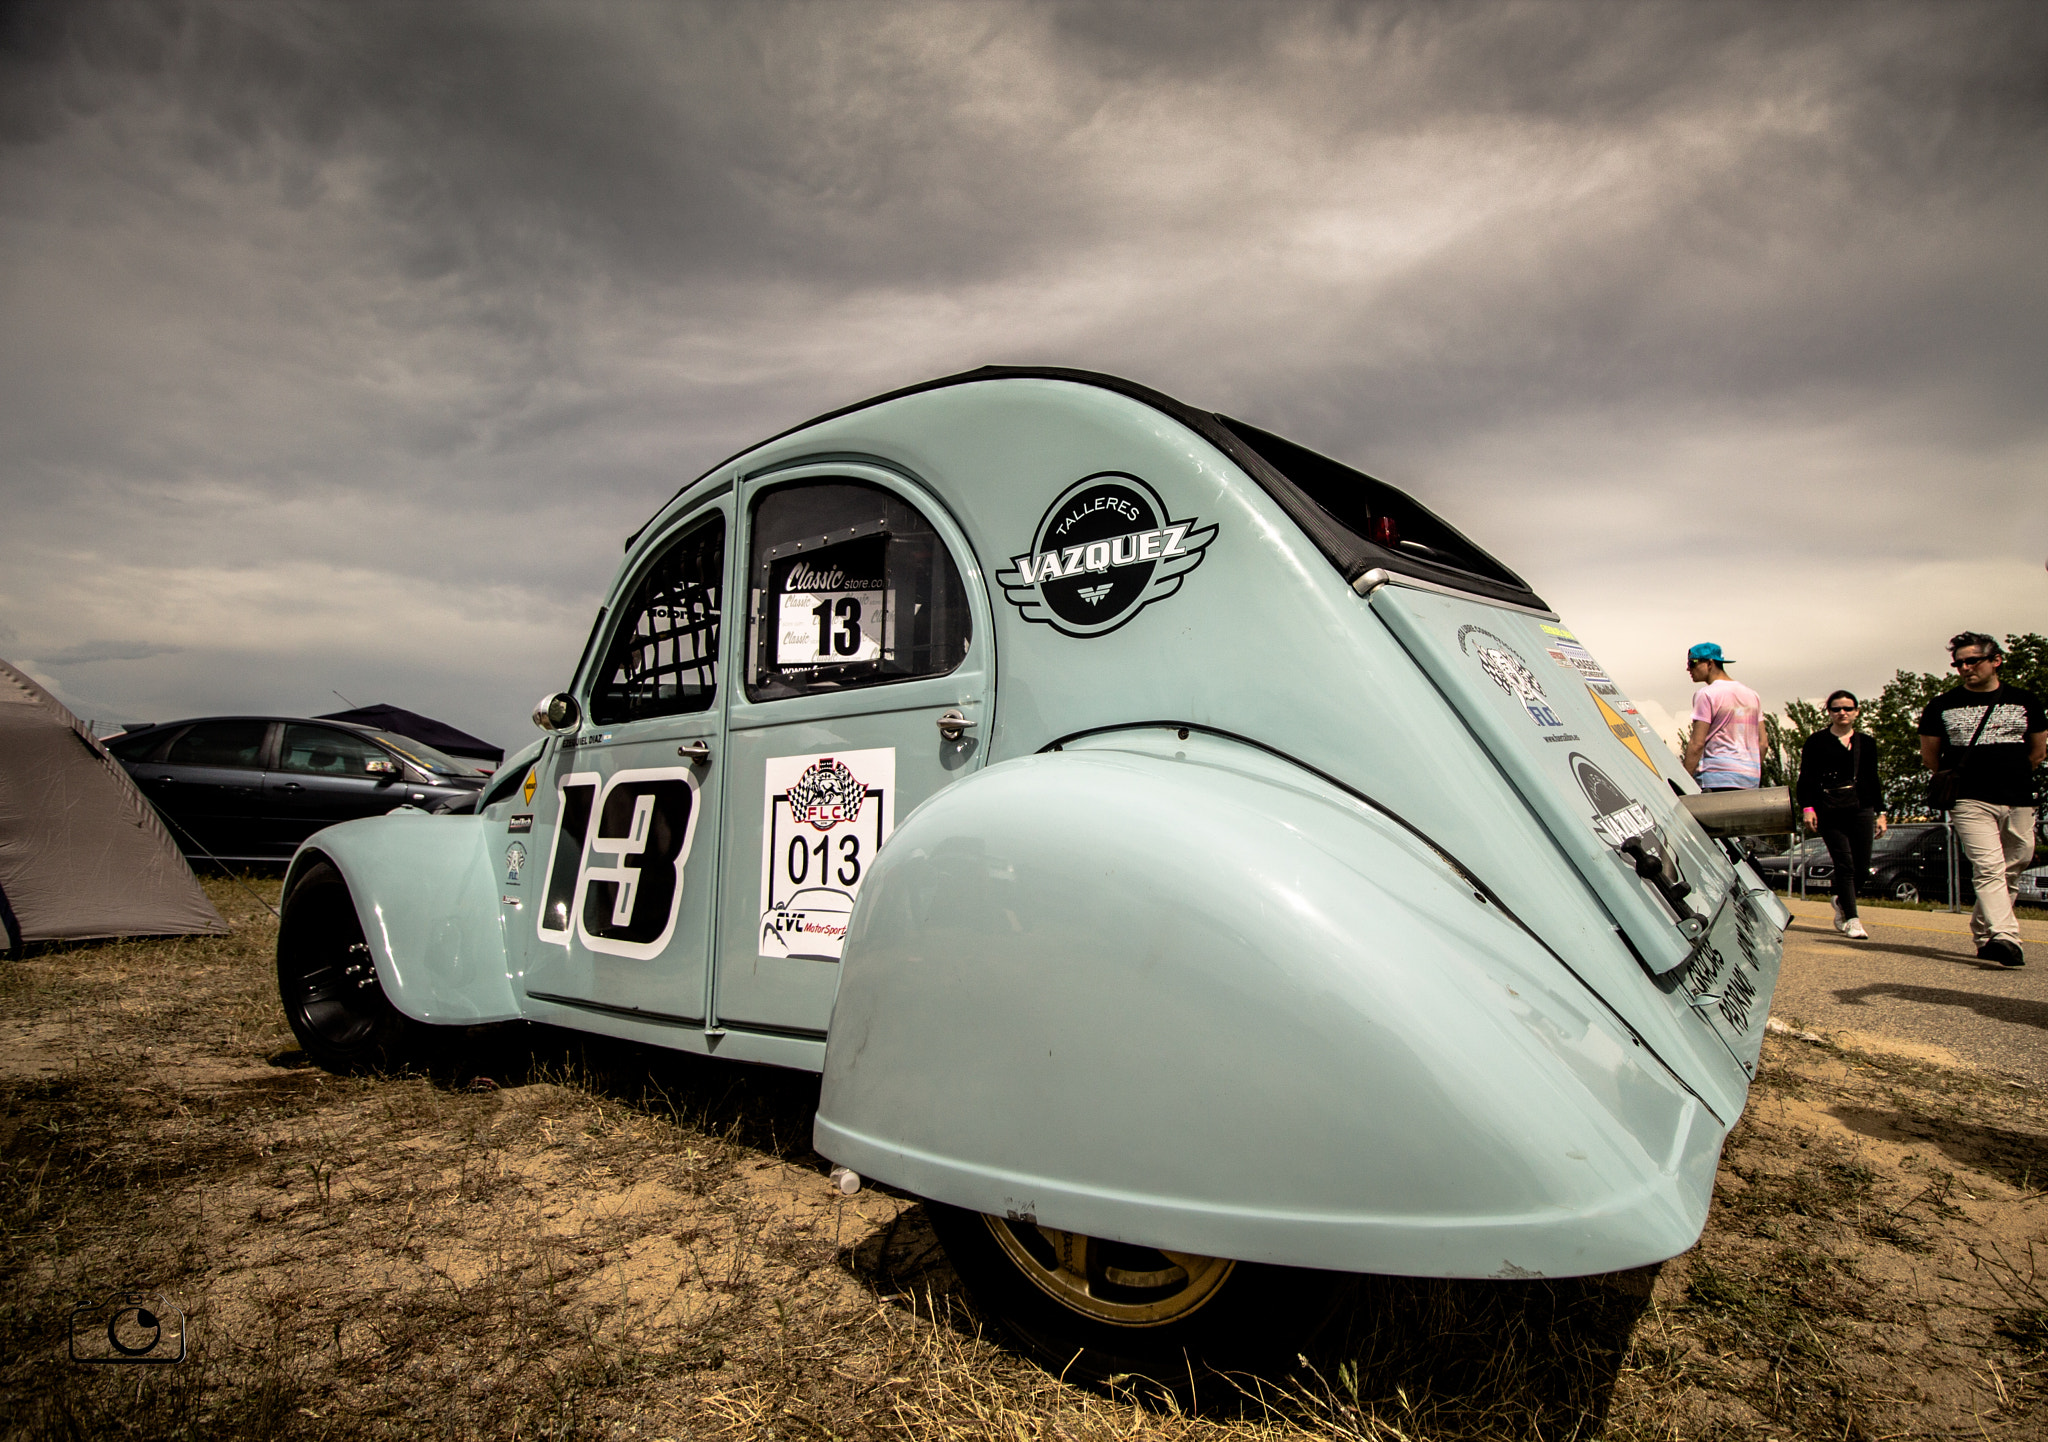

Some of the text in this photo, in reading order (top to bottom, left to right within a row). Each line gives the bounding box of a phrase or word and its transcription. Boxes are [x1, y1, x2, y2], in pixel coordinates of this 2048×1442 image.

[1056, 497, 1140, 537] TALLERES
[786, 562, 845, 592] Classic
[1018, 525, 1188, 585] VAZQUEZ
[812, 597, 862, 656] 13
[1528, 706, 1562, 726] FLC
[807, 805, 842, 820] FLC
[538, 767, 701, 960] 13
[787, 834, 861, 886] 013
[776, 912, 847, 936] CVC MotorSport
[1687, 938, 1725, 994] GRACIAS
